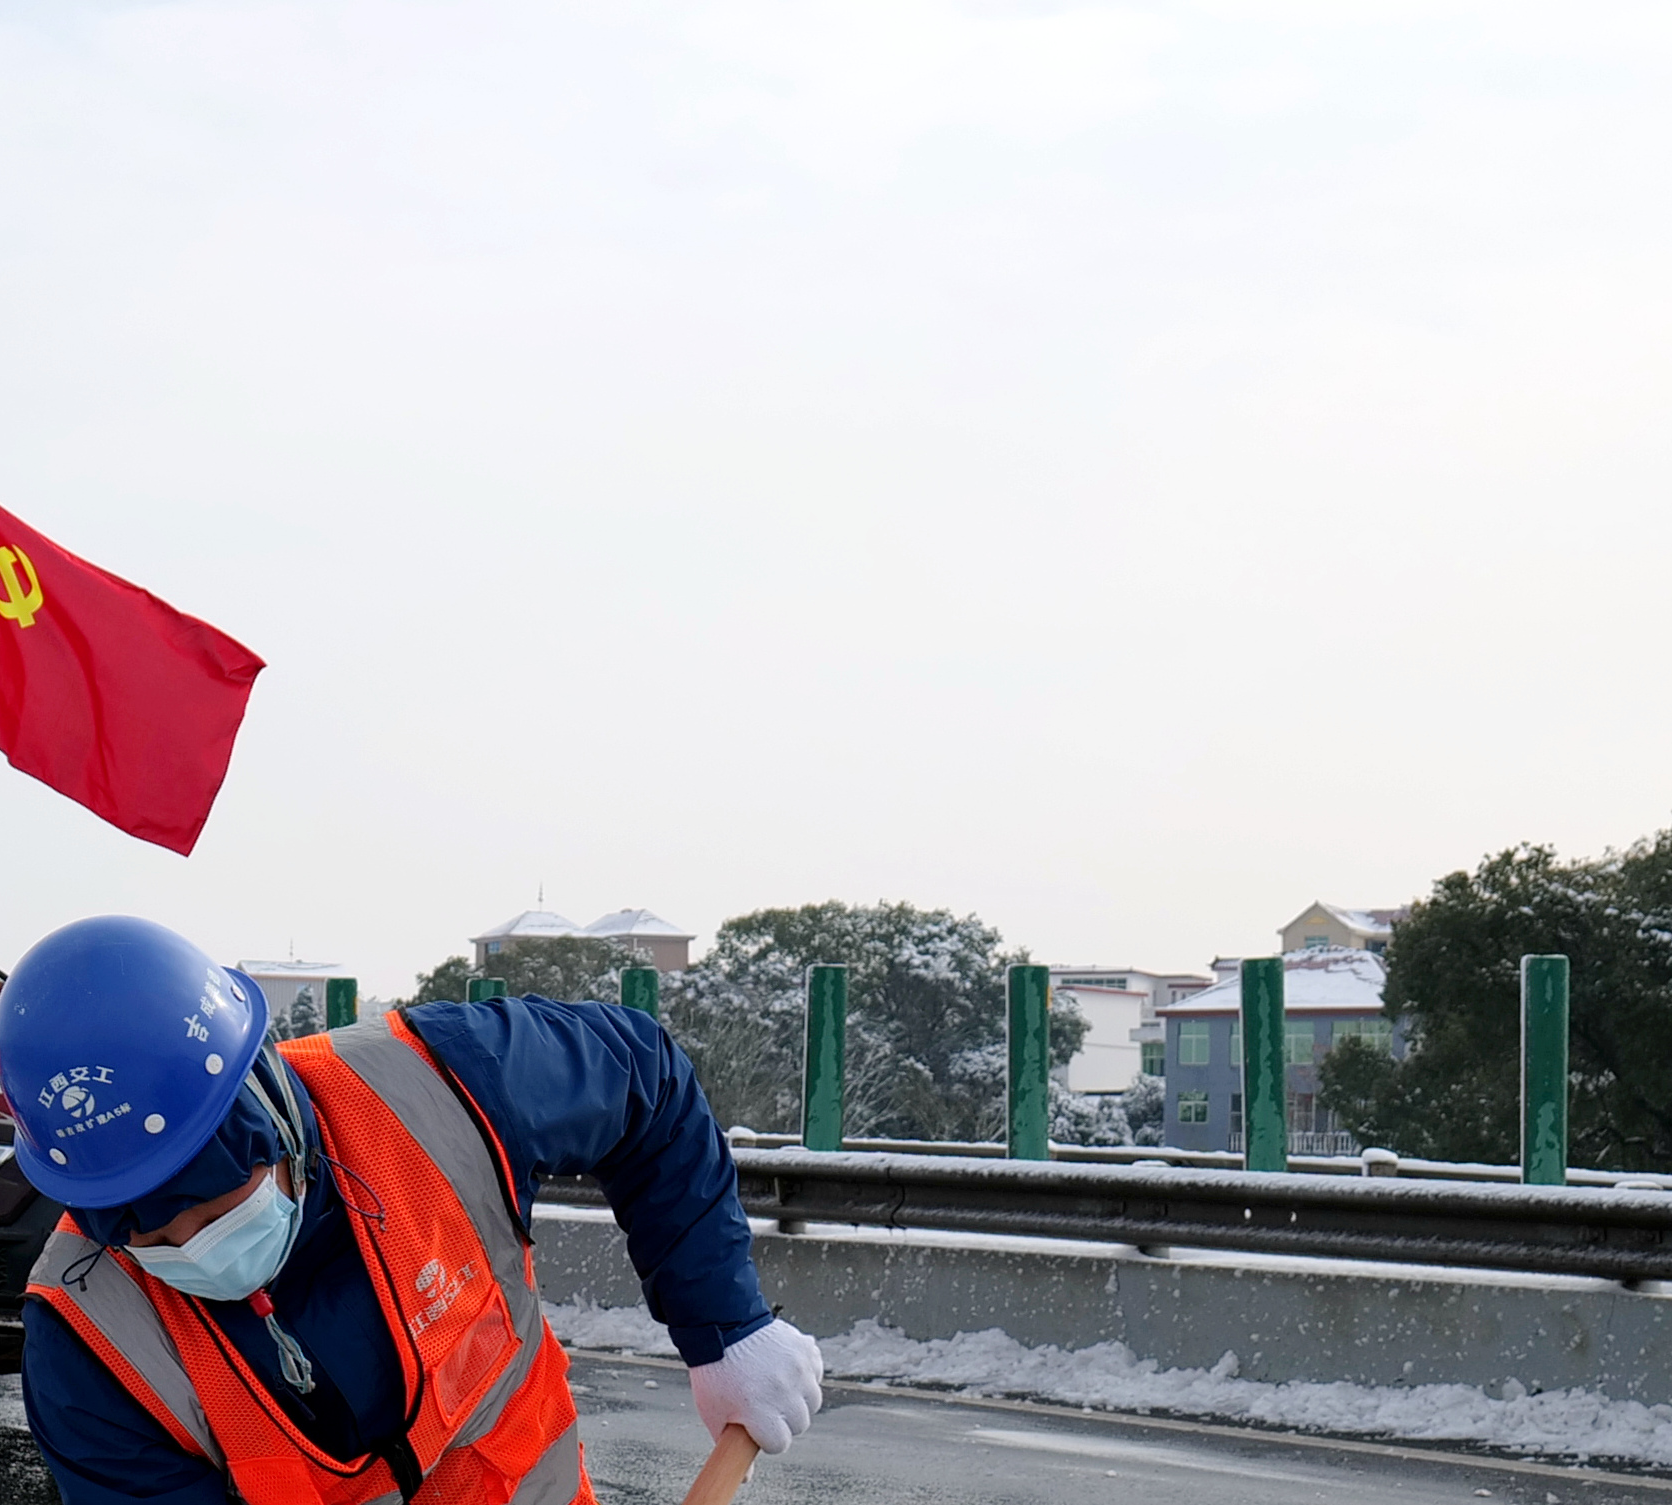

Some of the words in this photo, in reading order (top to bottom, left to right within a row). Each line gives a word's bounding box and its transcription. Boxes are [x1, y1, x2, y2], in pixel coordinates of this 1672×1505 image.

[37, 1065, 115, 1109] 江西交工
[407, 1260, 480, 1341] 江西交工
